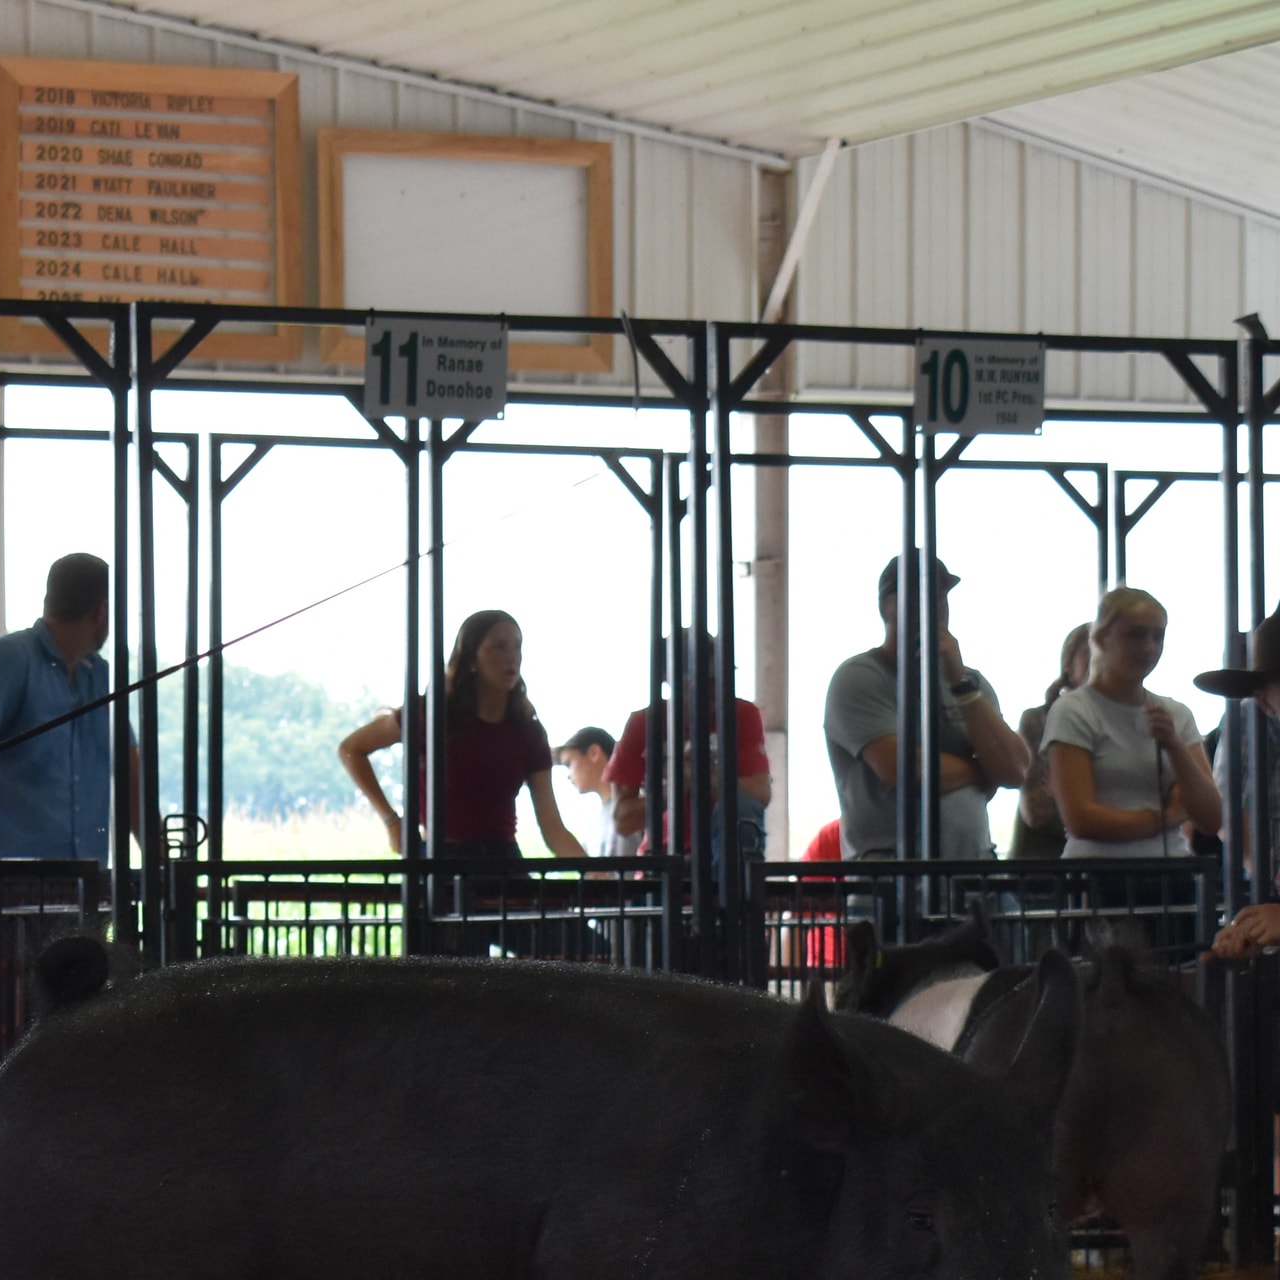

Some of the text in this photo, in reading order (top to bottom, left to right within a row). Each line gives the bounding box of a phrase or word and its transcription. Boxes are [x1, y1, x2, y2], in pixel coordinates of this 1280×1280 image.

[35, 88, 76, 105] 2018
[91, 91, 151, 110] VICTORIA
[35, 117, 76, 134] 2019
[36, 147, 82, 162] 2020
[148, 152, 202, 169] CONRAD
[35, 174, 76, 191] 2021
[148, 179, 216, 199] FAULKNER
[35, 202, 82, 220] 2022
[149, 209, 198, 225] WILSON
[36, 231, 198, 256] 2023 CALE HALL
[36, 260, 199, 286] 2024 CALE HALL
[421, 335, 502, 352] In Memory of
[370, 330, 419, 406] 11
[437, 353, 483, 373] Ranae
[975, 356, 1038, 367] In Memory of
[921, 348, 969, 424] 10
[999, 369, 1040, 385] RUNYAN
[426, 379, 493, 400] Donohoe
[978, 391, 1036, 406] 1st PC Pres.
